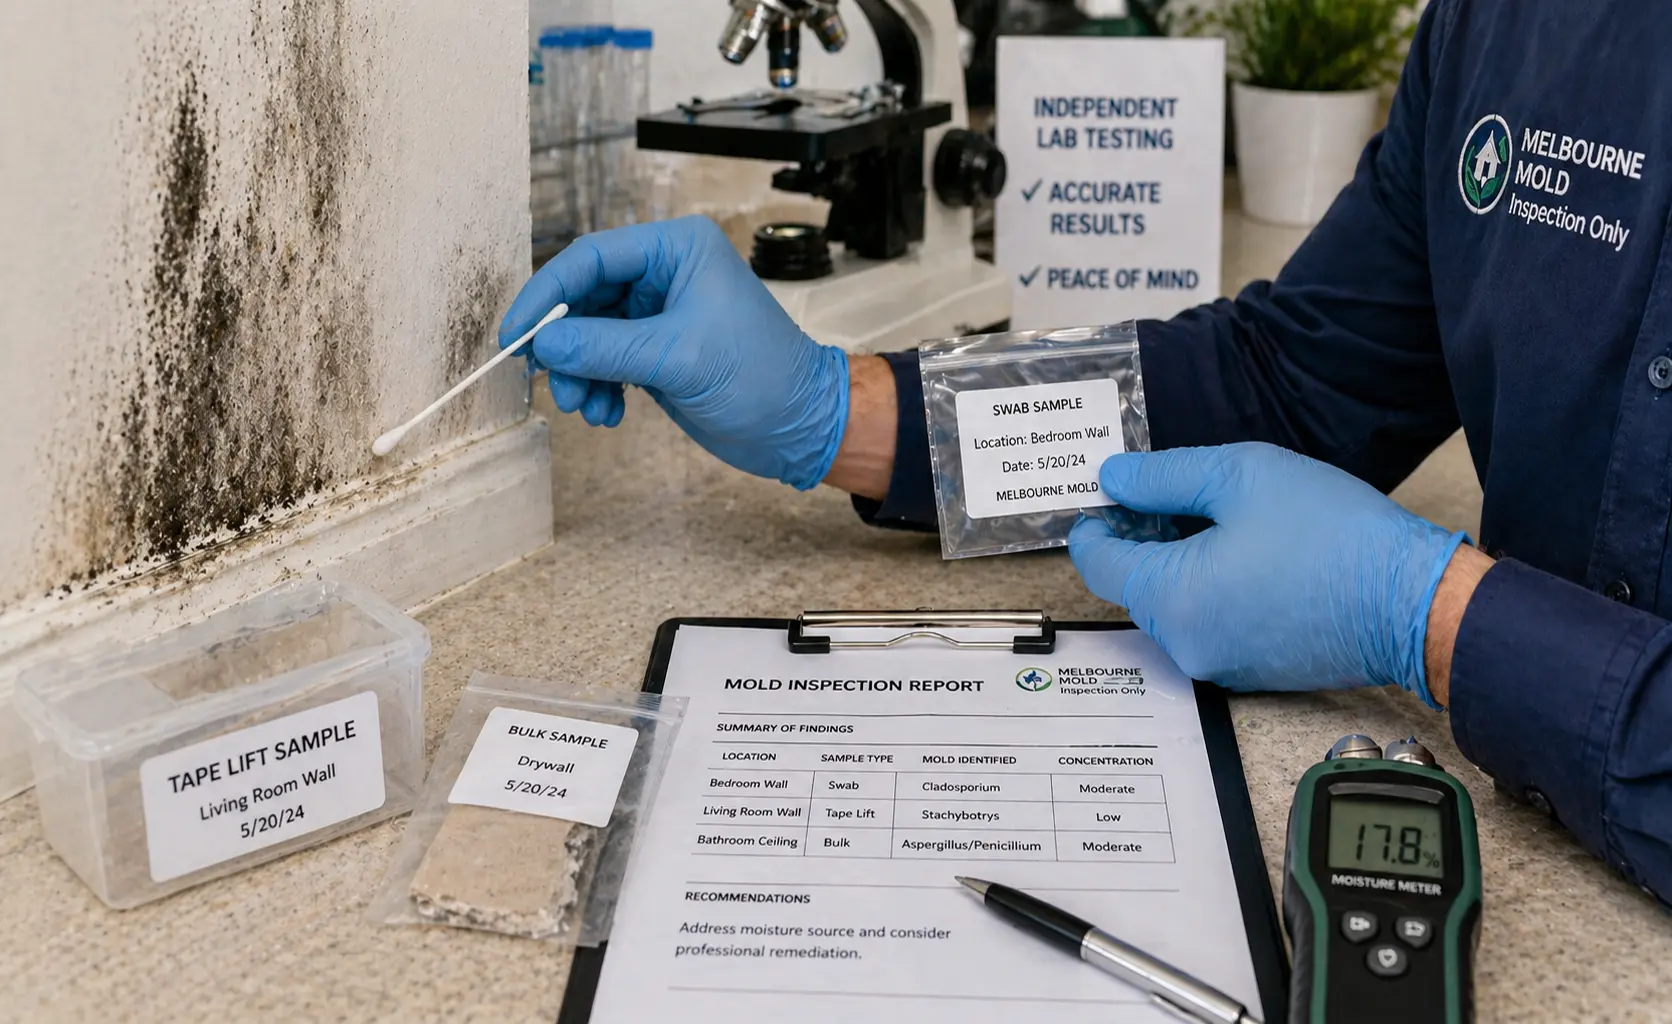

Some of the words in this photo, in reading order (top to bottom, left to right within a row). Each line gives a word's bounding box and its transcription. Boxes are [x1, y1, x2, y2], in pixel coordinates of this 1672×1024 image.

[1034, 97, 1178, 118] INDEPENDENT
[1037, 128, 1077, 148] LAB
[1085, 128, 1173, 149] TESTING
[1521, 128, 1645, 179] MELBOURNE
[1515, 161, 1570, 196] MOLD
[1048, 182, 1160, 203] ACCURATE
[1051, 214, 1145, 234] RESULTS
[1509, 193, 1586, 234] Inspection
[1589, 215, 1630, 251] Only
[1047, 268, 1109, 289] PEACE
[1115, 269, 1141, 289] OF
[1146, 270, 1198, 289] MIND
[993, 403, 1029, 416] SWAB
[1033, 398, 1082, 412] SAMPLE
[974, 434, 1027, 449] Location:
[1031, 429, 1082, 444] Bedroom
[1085, 426, 1109, 438] Wall
[1003, 460, 1033, 472] Date:
[1038, 454, 1085, 469] 5/20/24
[996, 485, 1064, 501] MELBOURNE
[1067, 482, 1098, 494] MOLD
[1058, 668, 1141, 676] MELBOURNE
[724, 679, 782, 690] MOLD
[788, 680, 902, 691] INSPECTION
[909, 680, 984, 692] REPORT
[1059, 677, 1097, 685] MOLD
[1061, 687, 1117, 695] Inspection
[1121, 686, 1146, 696] Only
[717, 723, 777, 732] SUMMARY
[781, 724, 796, 732] OF
[799, 725, 854, 733] FINDINGS
[508, 725, 547, 739] BULK
[549, 731, 608, 749] SAMPLE
[168, 762, 221, 793] TAPE
[228, 748, 268, 776] LIFT
[275, 720, 356, 761] SAMPLE
[722, 753, 776, 761] LOCATION
[821, 754, 864, 763] SAMPLE
[867, 754, 893, 763] TYPE
[922, 755, 955, 764] MOLD
[959, 756, 1017, 765] IDENTIFIED
[1058, 757, 1153, 766] CONCENTRATION
[518, 755, 574, 773] Drywall
[505, 780, 567, 798] 5/20/24
[710, 779, 760, 788] Bedroom
[764, 780, 788, 789] Wall
[829, 781, 859, 790] Swab
[922, 782, 1000, 793] Cladosporium
[1079, 784, 1135, 794] Moderate
[200, 795, 248, 821] Living
[253, 780, 298, 804] Room
[302, 763, 336, 787] Wall
[703, 806, 736, 818] Living
[740, 807, 773, 817] Room
[777, 808, 801, 817] Wall
[825, 808, 852, 819] Tape
[856, 809, 875, 818] Lift
[922, 810, 999, 821] Stachybotrys
[1096, 813, 1121, 821] Low
[240, 805, 305, 838] 5/20/24
[697, 835, 755, 846] Bathroom
[758, 836, 798, 849] Ceiling
[824, 838, 850, 847] Bulk
[902, 840, 1041, 852] Aspergillus/Penicillium
[1083, 842, 1142, 852] Moderate
[1332, 874, 1396, 891] MOISTURE
[1398, 881, 1441, 895] METER
[685, 892, 811, 904] RECOMMENDATIONS
[679, 922, 736, 934] Address
[740, 924, 803, 936] moisture
[807, 927, 854, 938] source
[859, 927, 885, 938] and
[890, 927, 951, 939] consider
[675, 944, 765, 958] professional
[769, 947, 862, 960] remediation.
